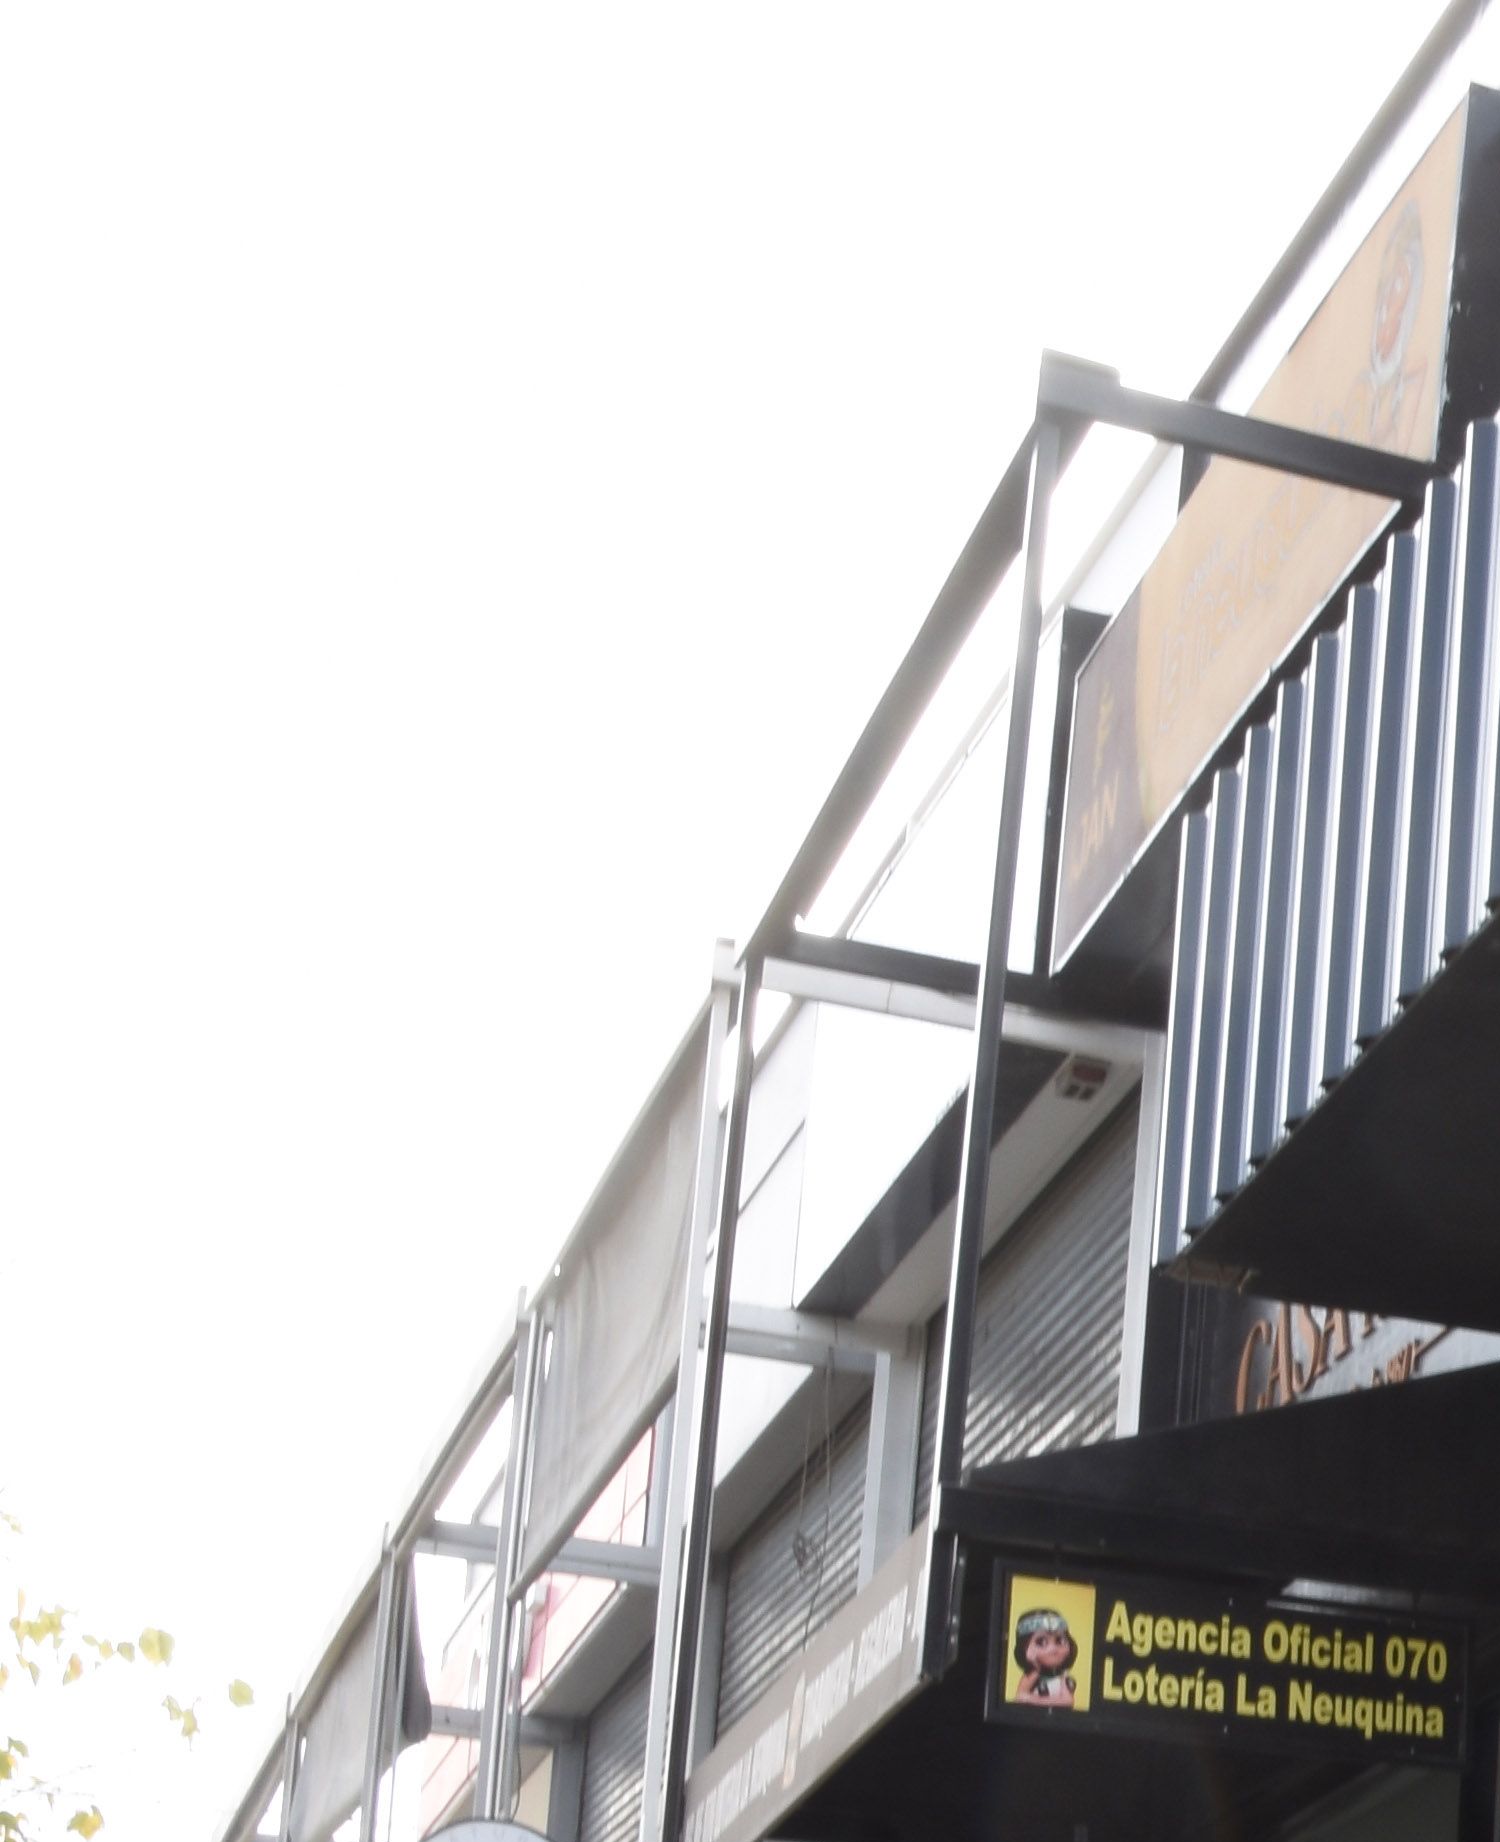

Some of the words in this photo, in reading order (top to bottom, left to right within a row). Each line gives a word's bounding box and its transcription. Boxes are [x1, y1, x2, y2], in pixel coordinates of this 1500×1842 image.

[1106, 1601, 1250, 1659] Agencia
[1263, 1619, 1374, 1676] Oficial
[1386, 1638, 1448, 1683] 070
[1103, 1659, 1224, 1714] Lotería
[1237, 1673, 1277, 1720] La
[1288, 1681, 1444, 1739] Neuquina
